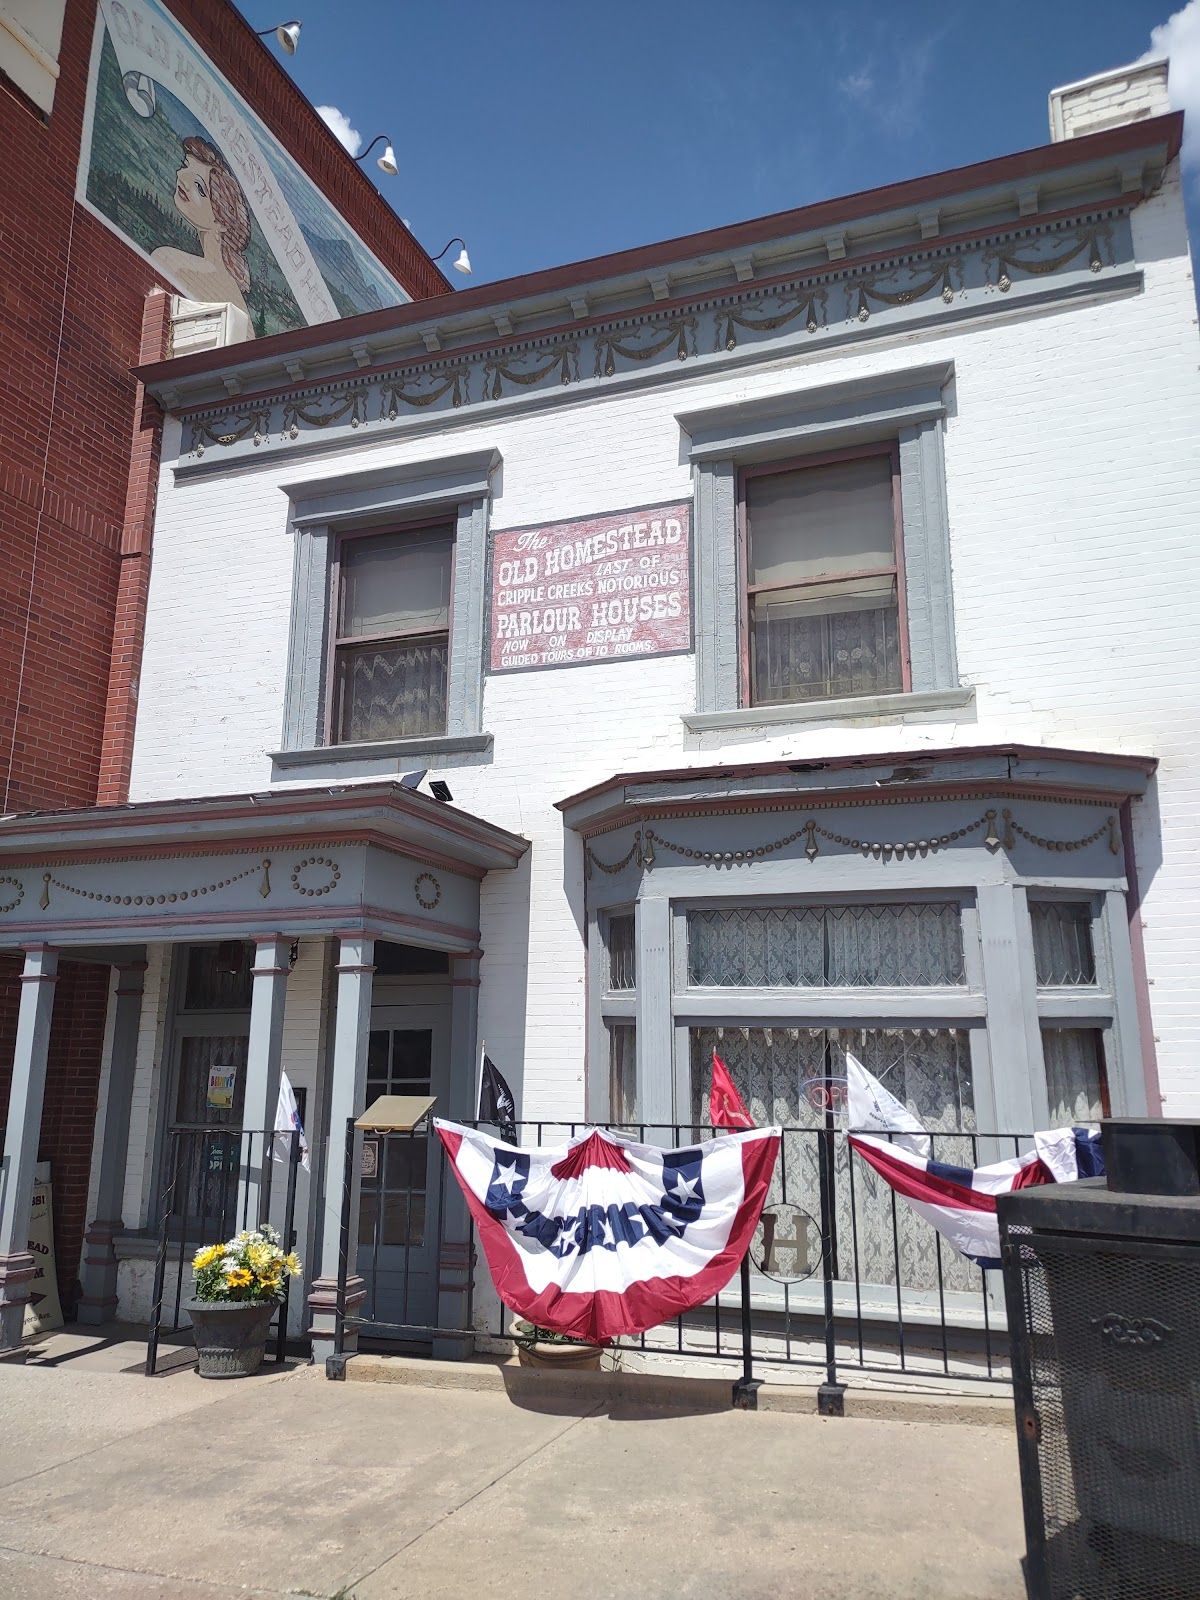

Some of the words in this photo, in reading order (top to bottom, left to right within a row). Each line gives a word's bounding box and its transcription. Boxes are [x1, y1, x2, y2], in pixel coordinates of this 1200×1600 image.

[110, 0, 171, 70] OLD
[174, 50, 306, 272] HOMESTEAD
[498, 557, 539, 587] OLD
[544, 518, 682, 577] HOMESTEAD
[513, 531, 549, 552] The
[594, 558, 633, 577] LAST
[639, 554, 661, 570] OF
[497, 586, 545, 606] CRIPPLE
[597, 569, 681, 594] NOTORIOUS
[497, 606, 582, 639] PARLOUR
[591, 591, 682, 628] HOUSES
[501, 637, 530, 655] NOW
[548, 634, 568, 648] ON
[586, 626, 634, 645] DISPLAY
[501, 652, 539, 667] GUIDED
[540, 648, 575, 663] TOURS
[577, 645, 593, 657] OF
[595, 644, 609, 657] 10
[759, 1213, 813, 1275] H
